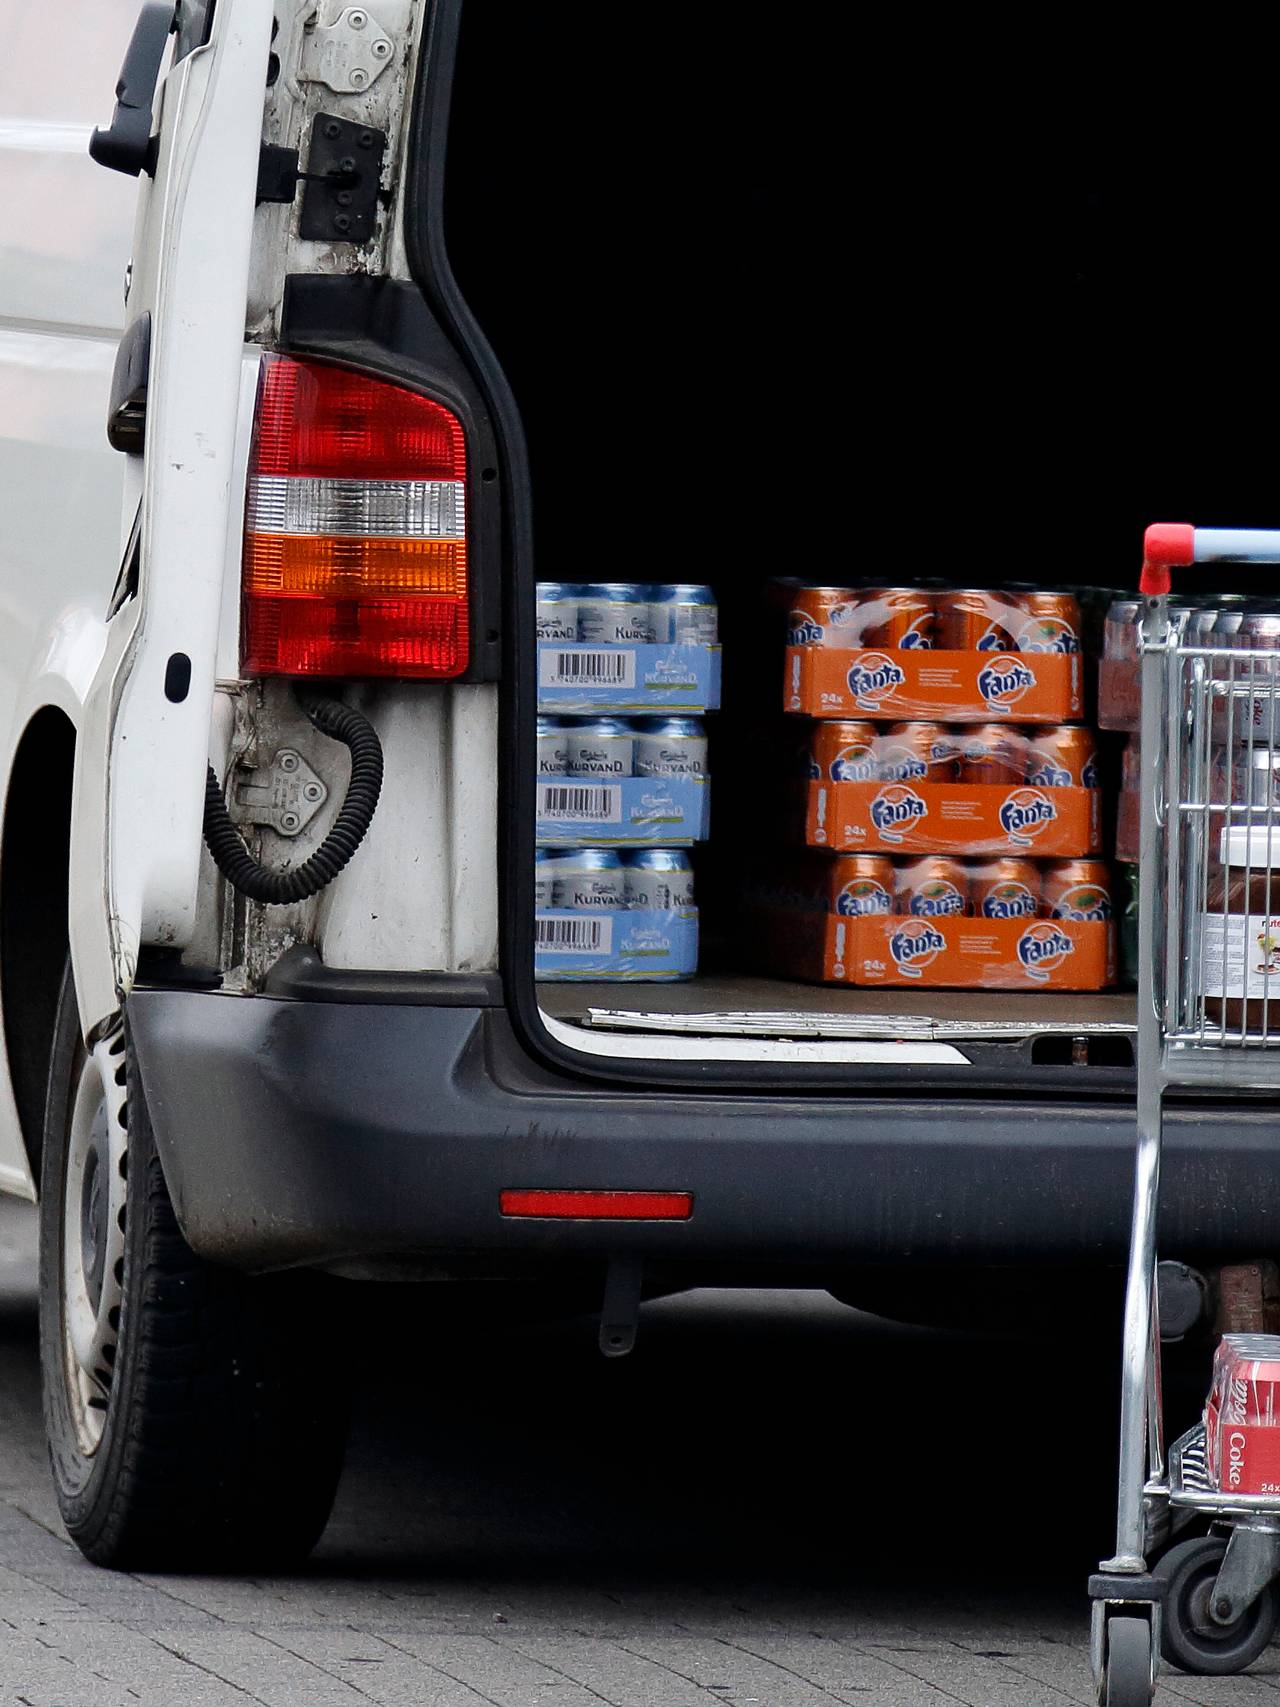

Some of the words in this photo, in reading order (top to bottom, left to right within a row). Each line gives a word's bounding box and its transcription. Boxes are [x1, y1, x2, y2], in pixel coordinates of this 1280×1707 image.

[848, 664, 904, 697] Fanta
[979, 666, 1036, 699] Fanta
[871, 796, 928, 829] Fanta
[1001, 800, 1056, 832] Fanta
[891, 930, 946, 962] Fanta
[1018, 933, 1074, 964] Fanta
[1229, 1432, 1247, 1485] Coke
[1261, 1483, 1280, 1493] 24x
